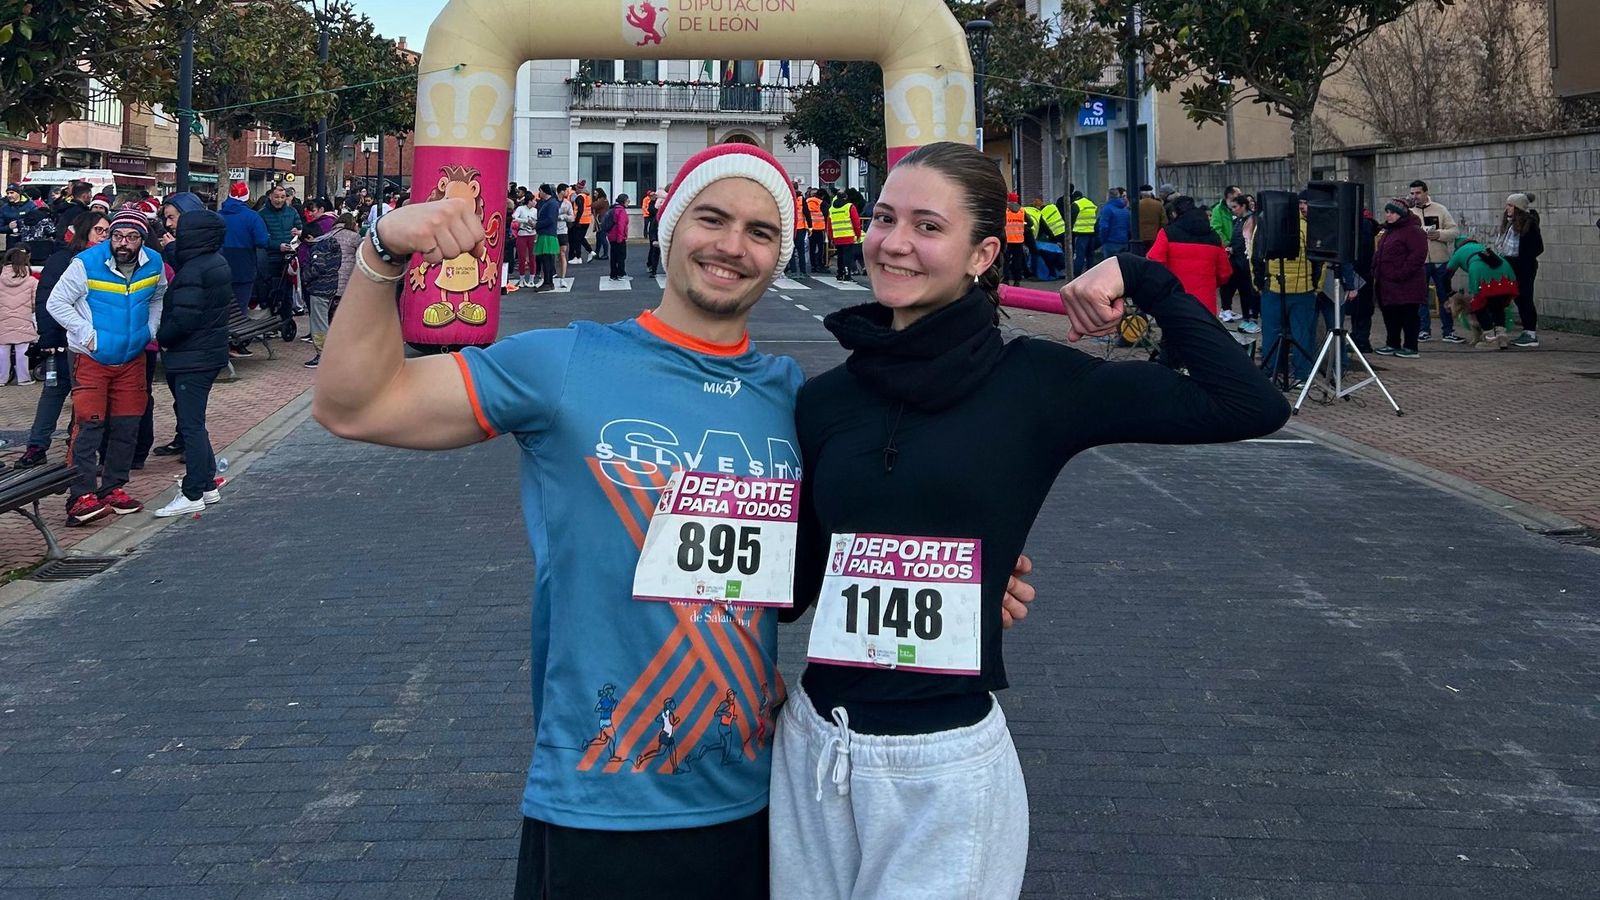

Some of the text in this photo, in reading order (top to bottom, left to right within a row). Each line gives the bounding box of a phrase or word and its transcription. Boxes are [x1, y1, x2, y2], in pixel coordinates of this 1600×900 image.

[679, 13, 759, 32] DE LEÓN
[1083, 117, 1104, 126] ATM
[703, 381, 733, 395] MKA
[680, 475, 795, 502] DEPORTE
[678, 496, 792, 518] PARA TODOS
[677, 521, 762, 576] 895
[851, 537, 975, 562] DEPORTE
[848, 558, 973, 580] PARA TODOS
[690, 610, 703, 623] de
[841, 583, 943, 641] 1148
